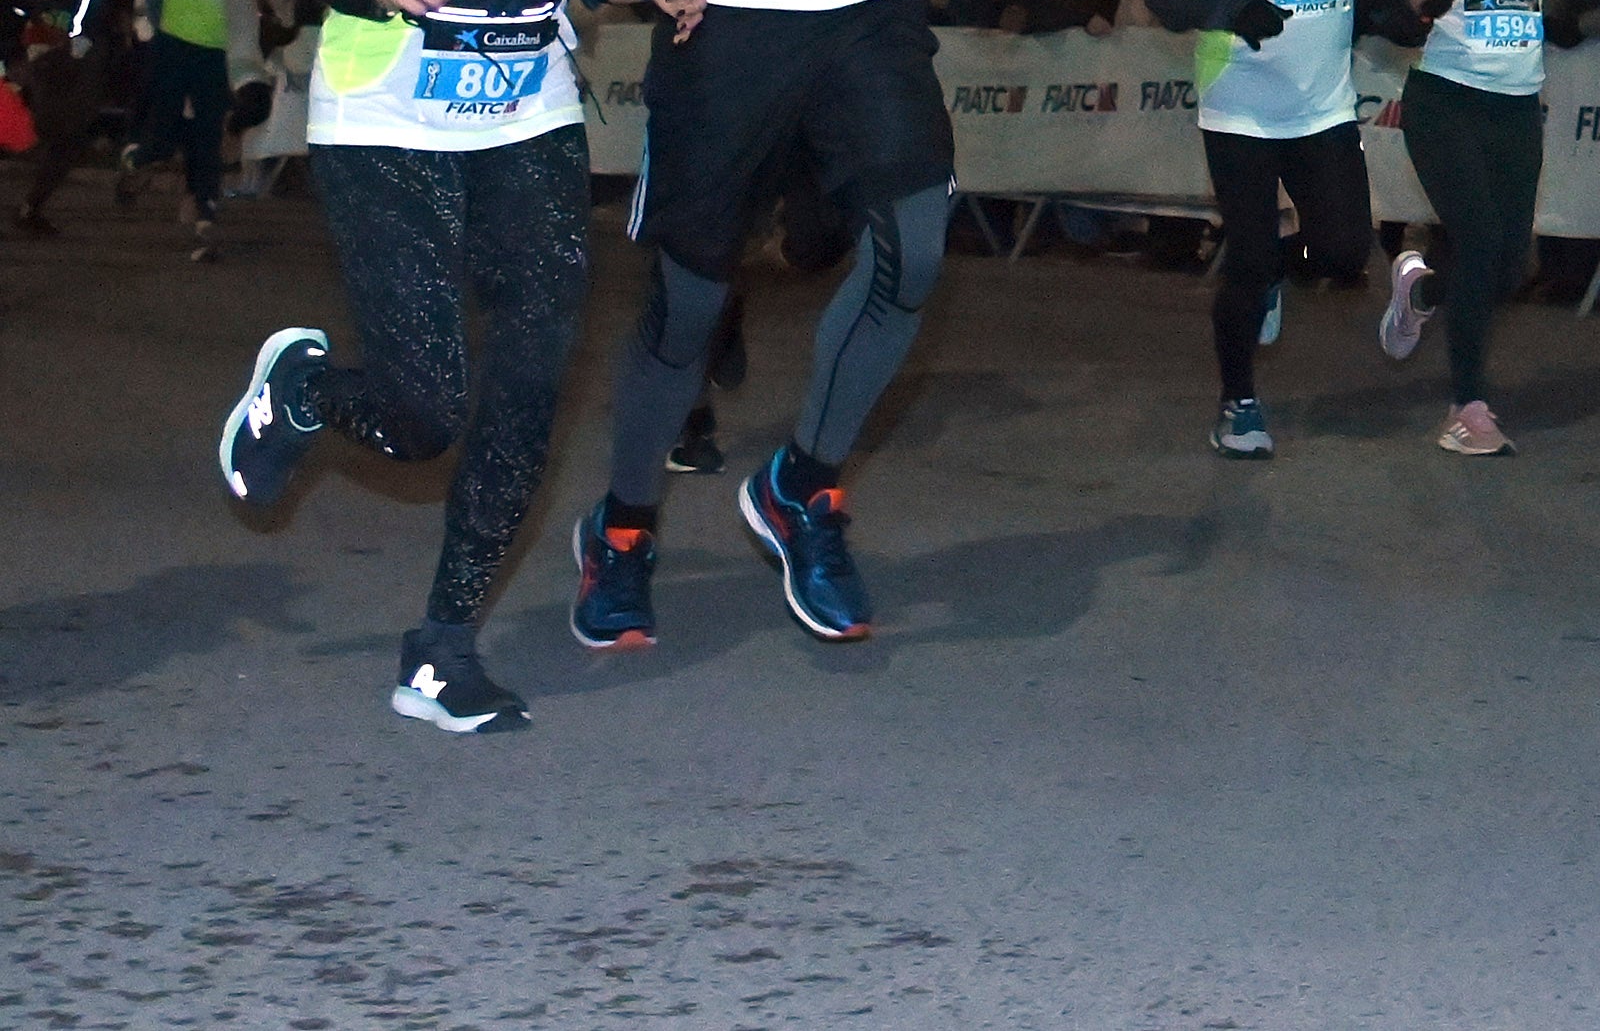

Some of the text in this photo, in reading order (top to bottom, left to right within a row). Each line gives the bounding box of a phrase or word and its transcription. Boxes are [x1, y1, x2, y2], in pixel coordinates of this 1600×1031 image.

[483, 31, 541, 46] CaixaBank
[1479, 16, 1538, 37] 1594
[455, 60, 536, 99] 807
[445, 101, 504, 114] FIATC
[951, 85, 1007, 114] FIATC
[1041, 83, 1098, 114] FIATC
[1138, 80, 1198, 111] FIATC
